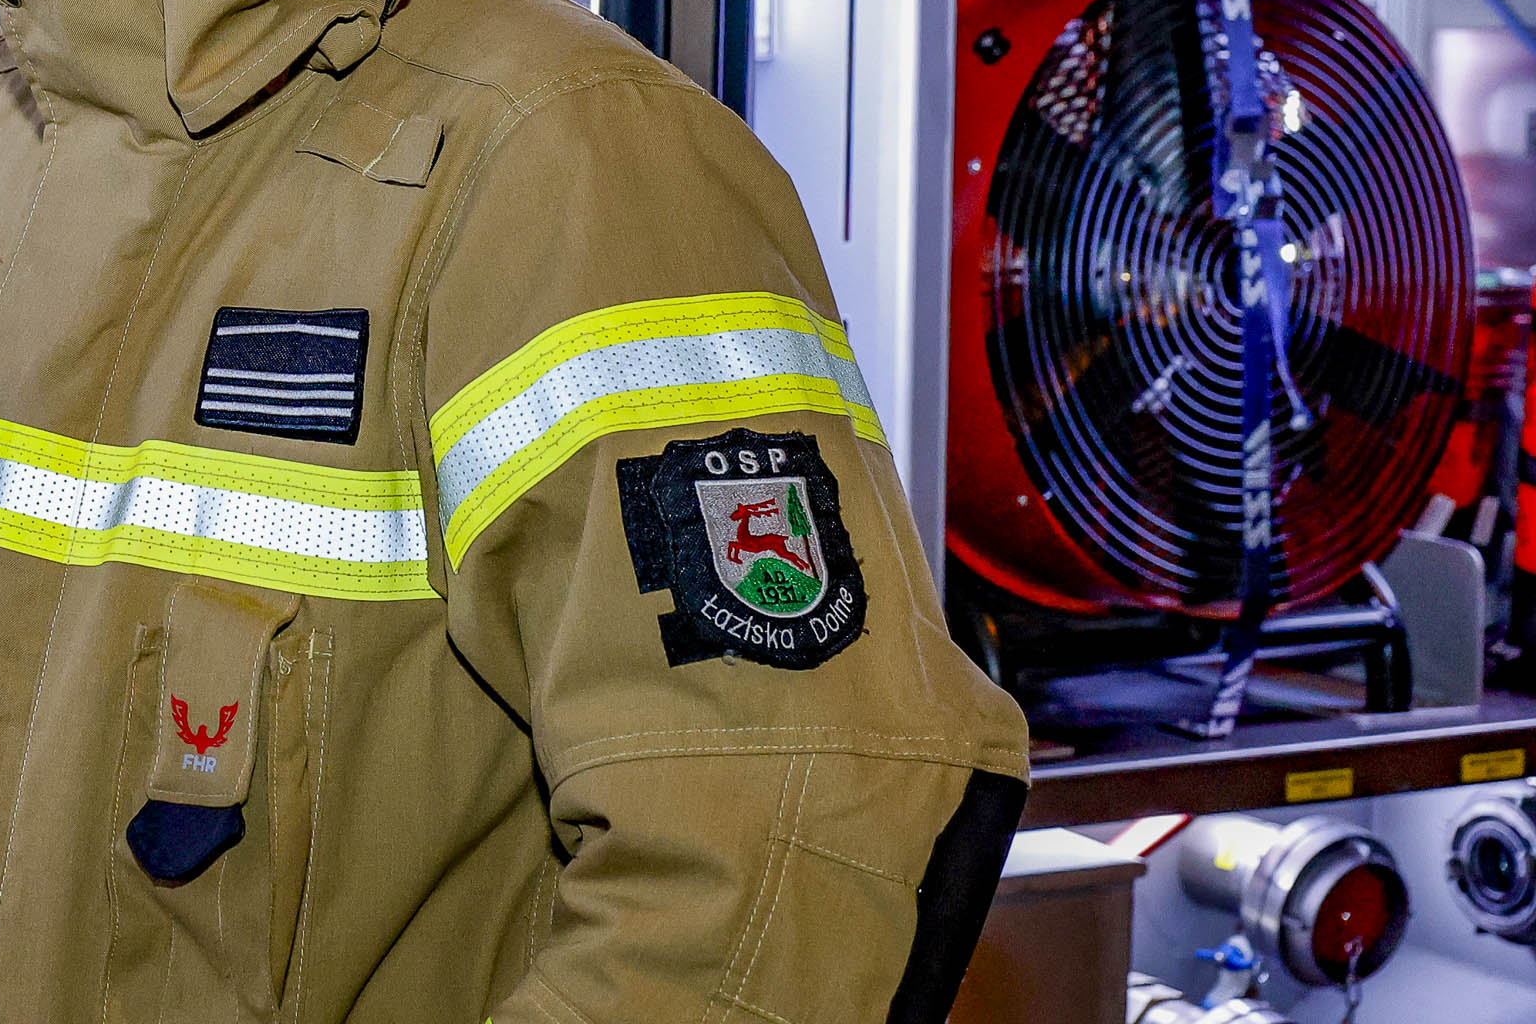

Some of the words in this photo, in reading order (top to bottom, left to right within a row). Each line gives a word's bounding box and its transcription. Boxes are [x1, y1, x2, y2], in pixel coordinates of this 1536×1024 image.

[704, 448, 787, 475] OSP
[809, 586, 853, 644] Dolne
[182, 753, 217, 774] FHR
